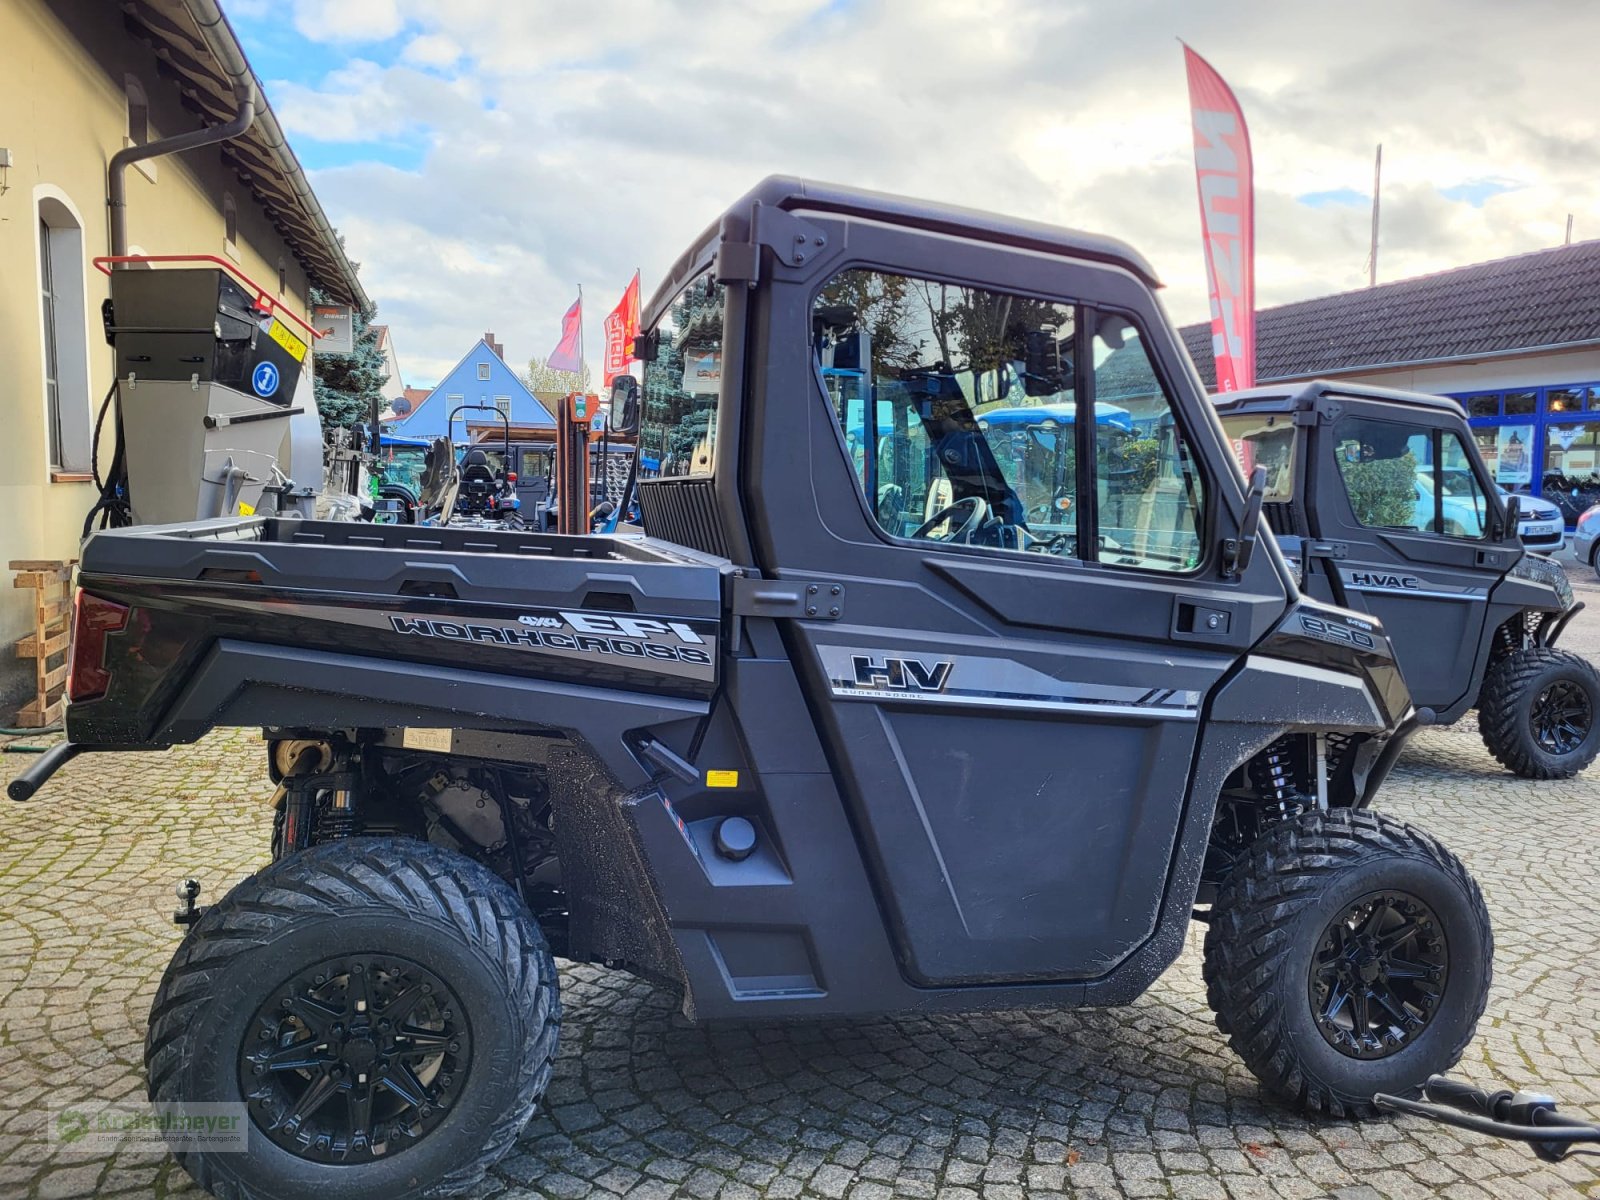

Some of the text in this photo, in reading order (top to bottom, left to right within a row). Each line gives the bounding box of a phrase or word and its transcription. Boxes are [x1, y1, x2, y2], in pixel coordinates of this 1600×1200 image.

[1351, 572, 1418, 590] HVAC
[388, 616, 713, 666] WORKCROSS
[1300, 614, 1375, 649] 850
[850, 654, 953, 691] HV
